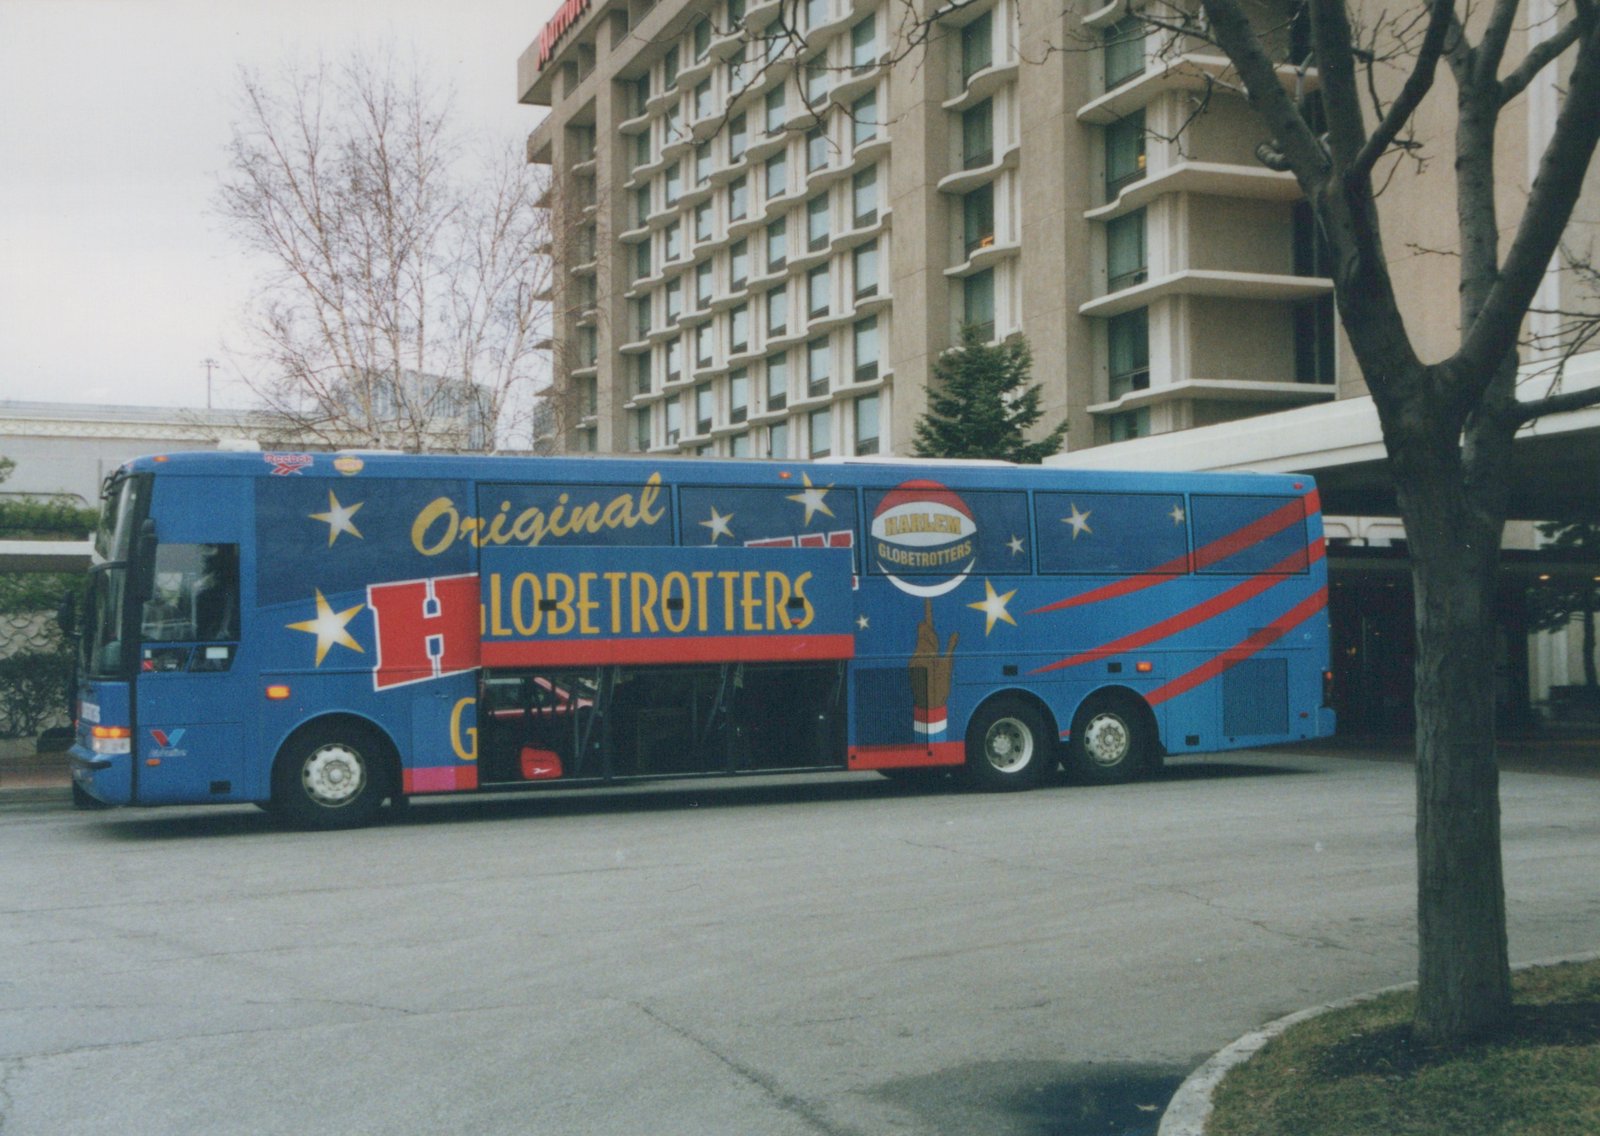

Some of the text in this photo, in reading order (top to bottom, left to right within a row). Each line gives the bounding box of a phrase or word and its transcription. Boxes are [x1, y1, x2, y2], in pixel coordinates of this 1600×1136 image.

[411, 471, 666, 556] Original
[884, 513, 962, 537] HARLEM
[878, 541, 972, 567] GLOBETROTTERS
[481, 570, 815, 636] LOBETROTTERS
